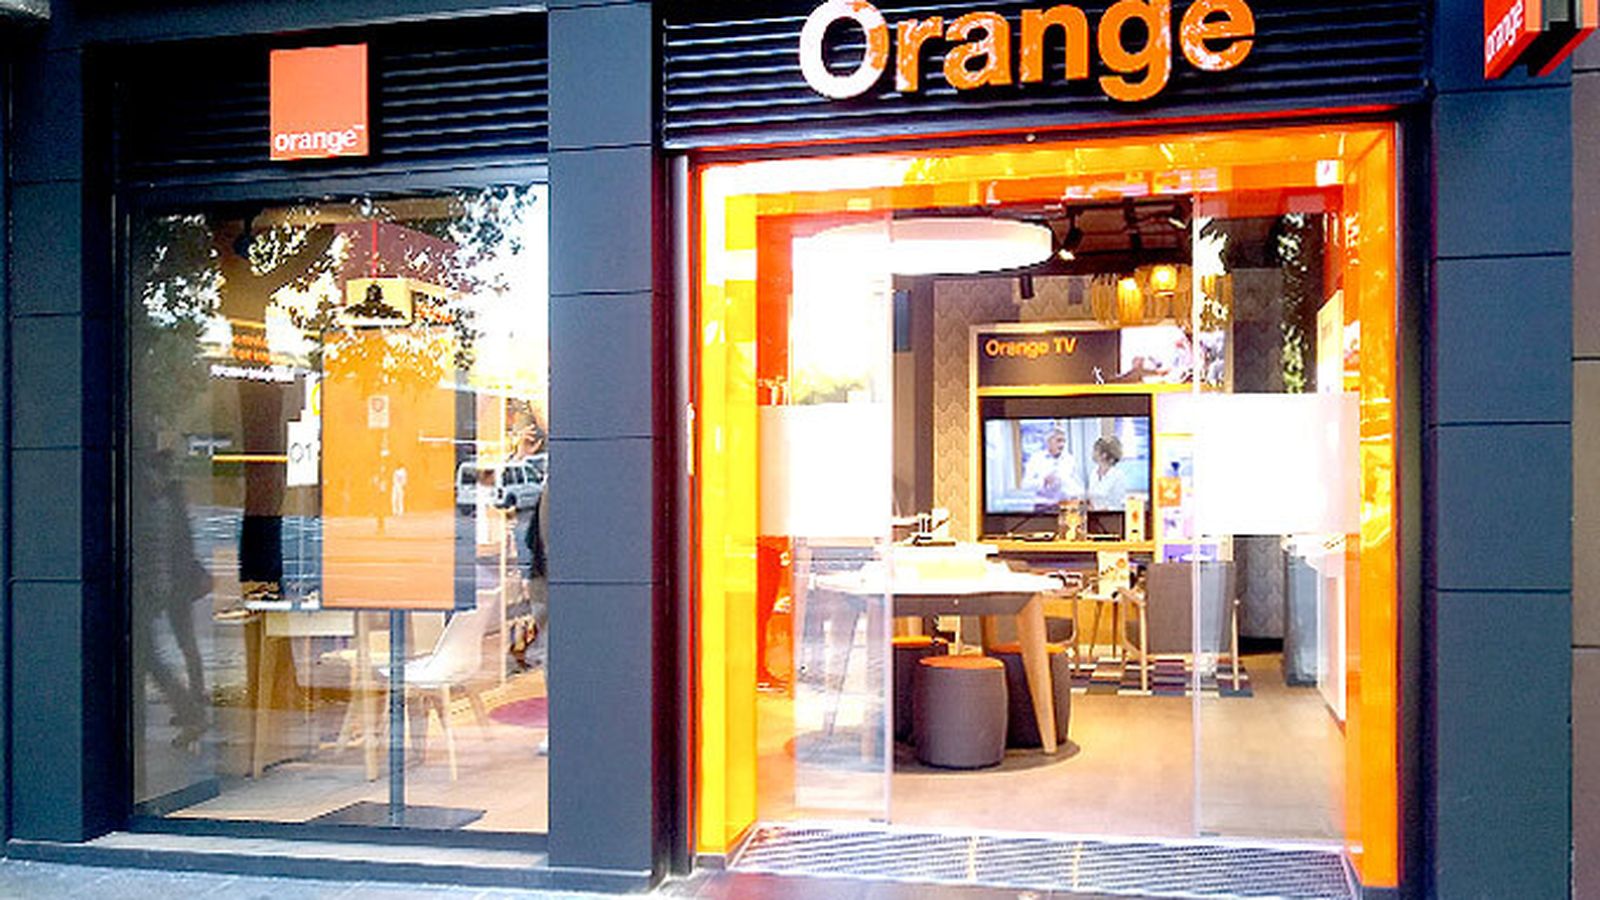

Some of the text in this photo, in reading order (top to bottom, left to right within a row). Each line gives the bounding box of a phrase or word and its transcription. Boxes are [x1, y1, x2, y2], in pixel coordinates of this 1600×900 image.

[799, 0, 1255, 101] Orange
[985, 337, 1077, 359] Orange TV
